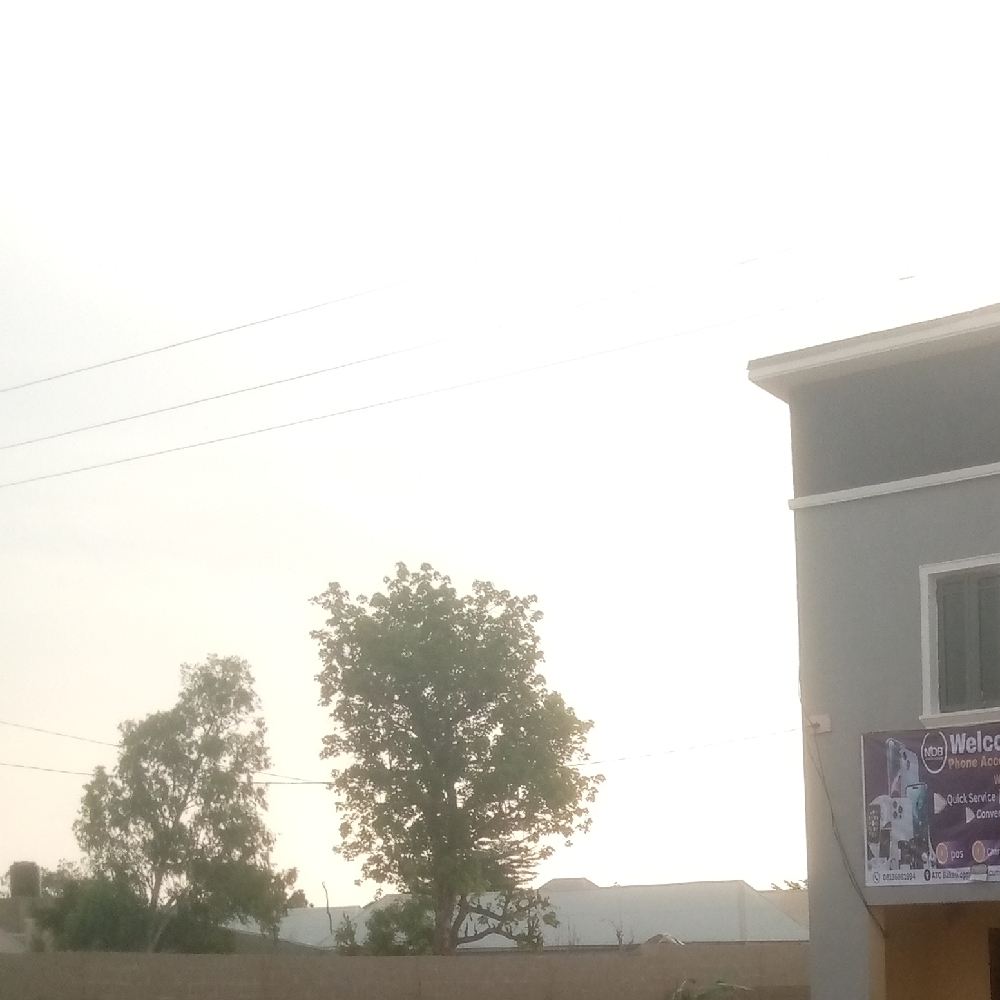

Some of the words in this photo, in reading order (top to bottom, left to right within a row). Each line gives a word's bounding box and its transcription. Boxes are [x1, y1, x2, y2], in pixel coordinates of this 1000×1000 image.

[948, 756, 977, 770] Phone
[947, 792, 967, 806] Quick
[968, 791, 996, 804] Service
